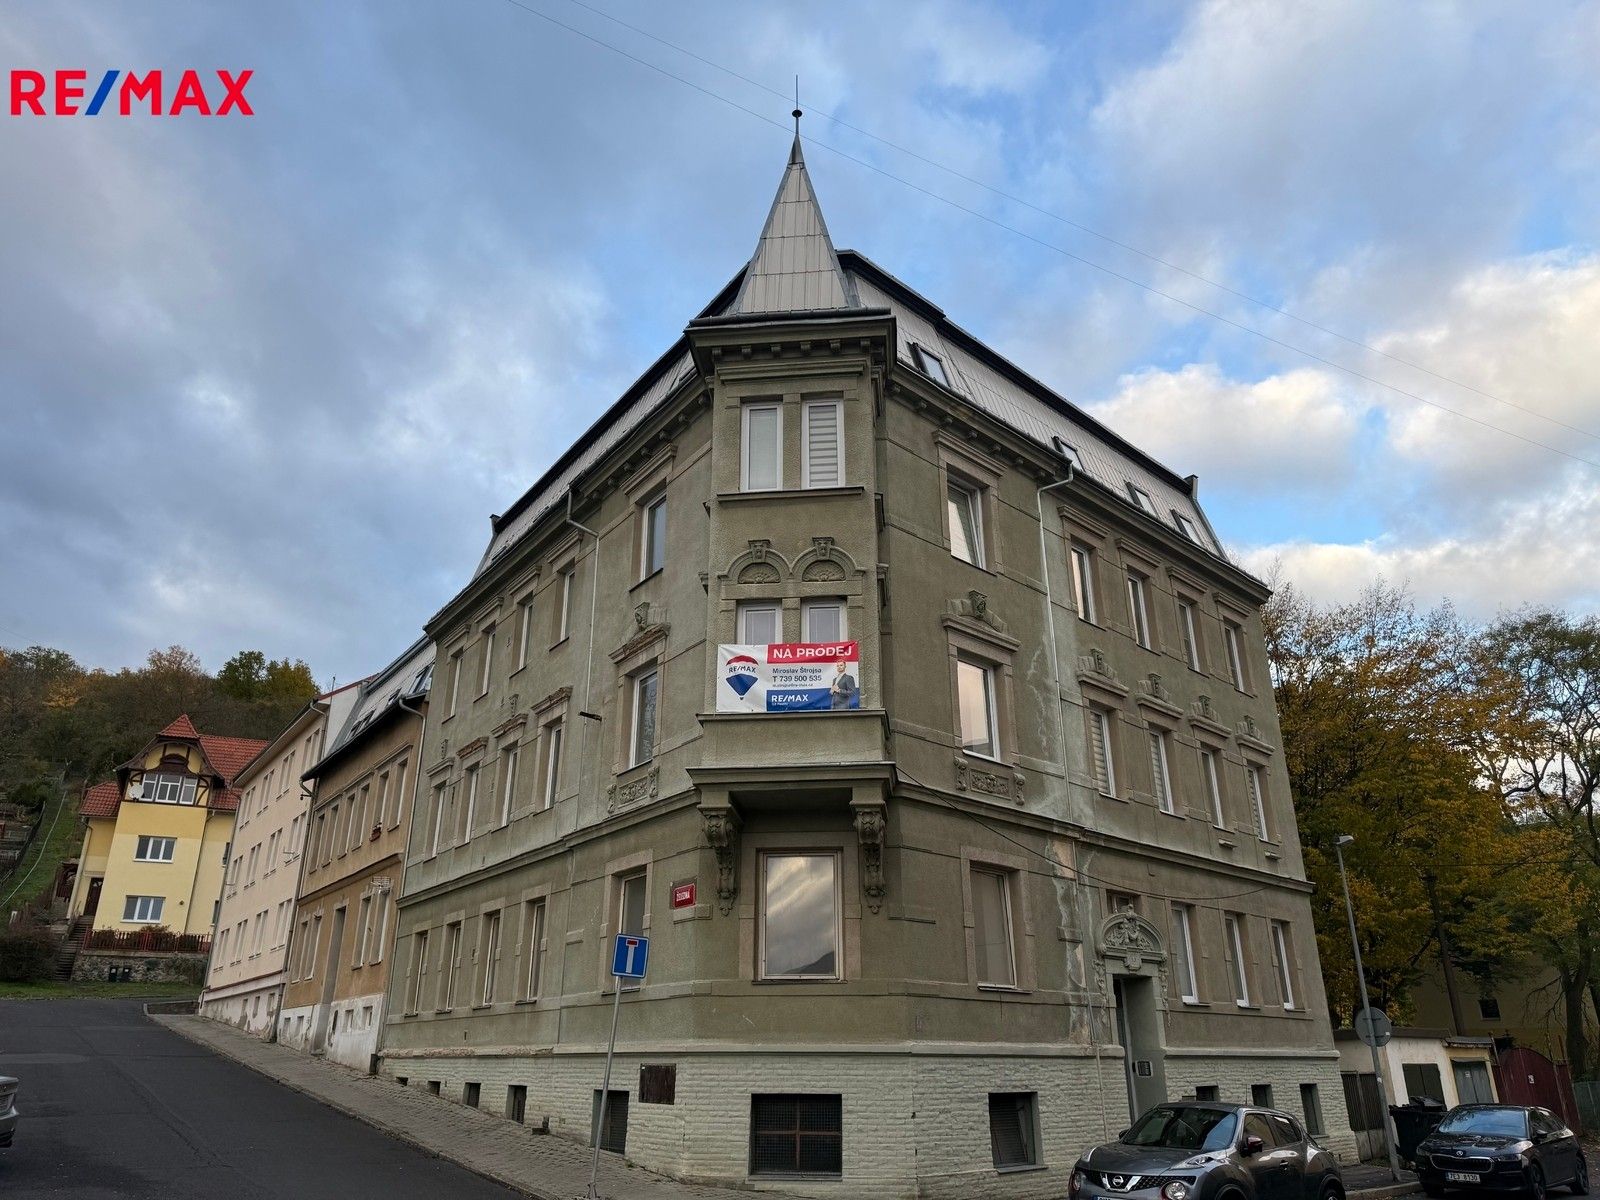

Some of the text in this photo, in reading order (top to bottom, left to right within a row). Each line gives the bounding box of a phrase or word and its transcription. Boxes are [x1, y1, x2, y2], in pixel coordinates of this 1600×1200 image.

[773, 646, 852, 658] NA PRODEJ
[728, 666, 756, 674] RE/MAX
[771, 694, 809, 702] RE/MAX
